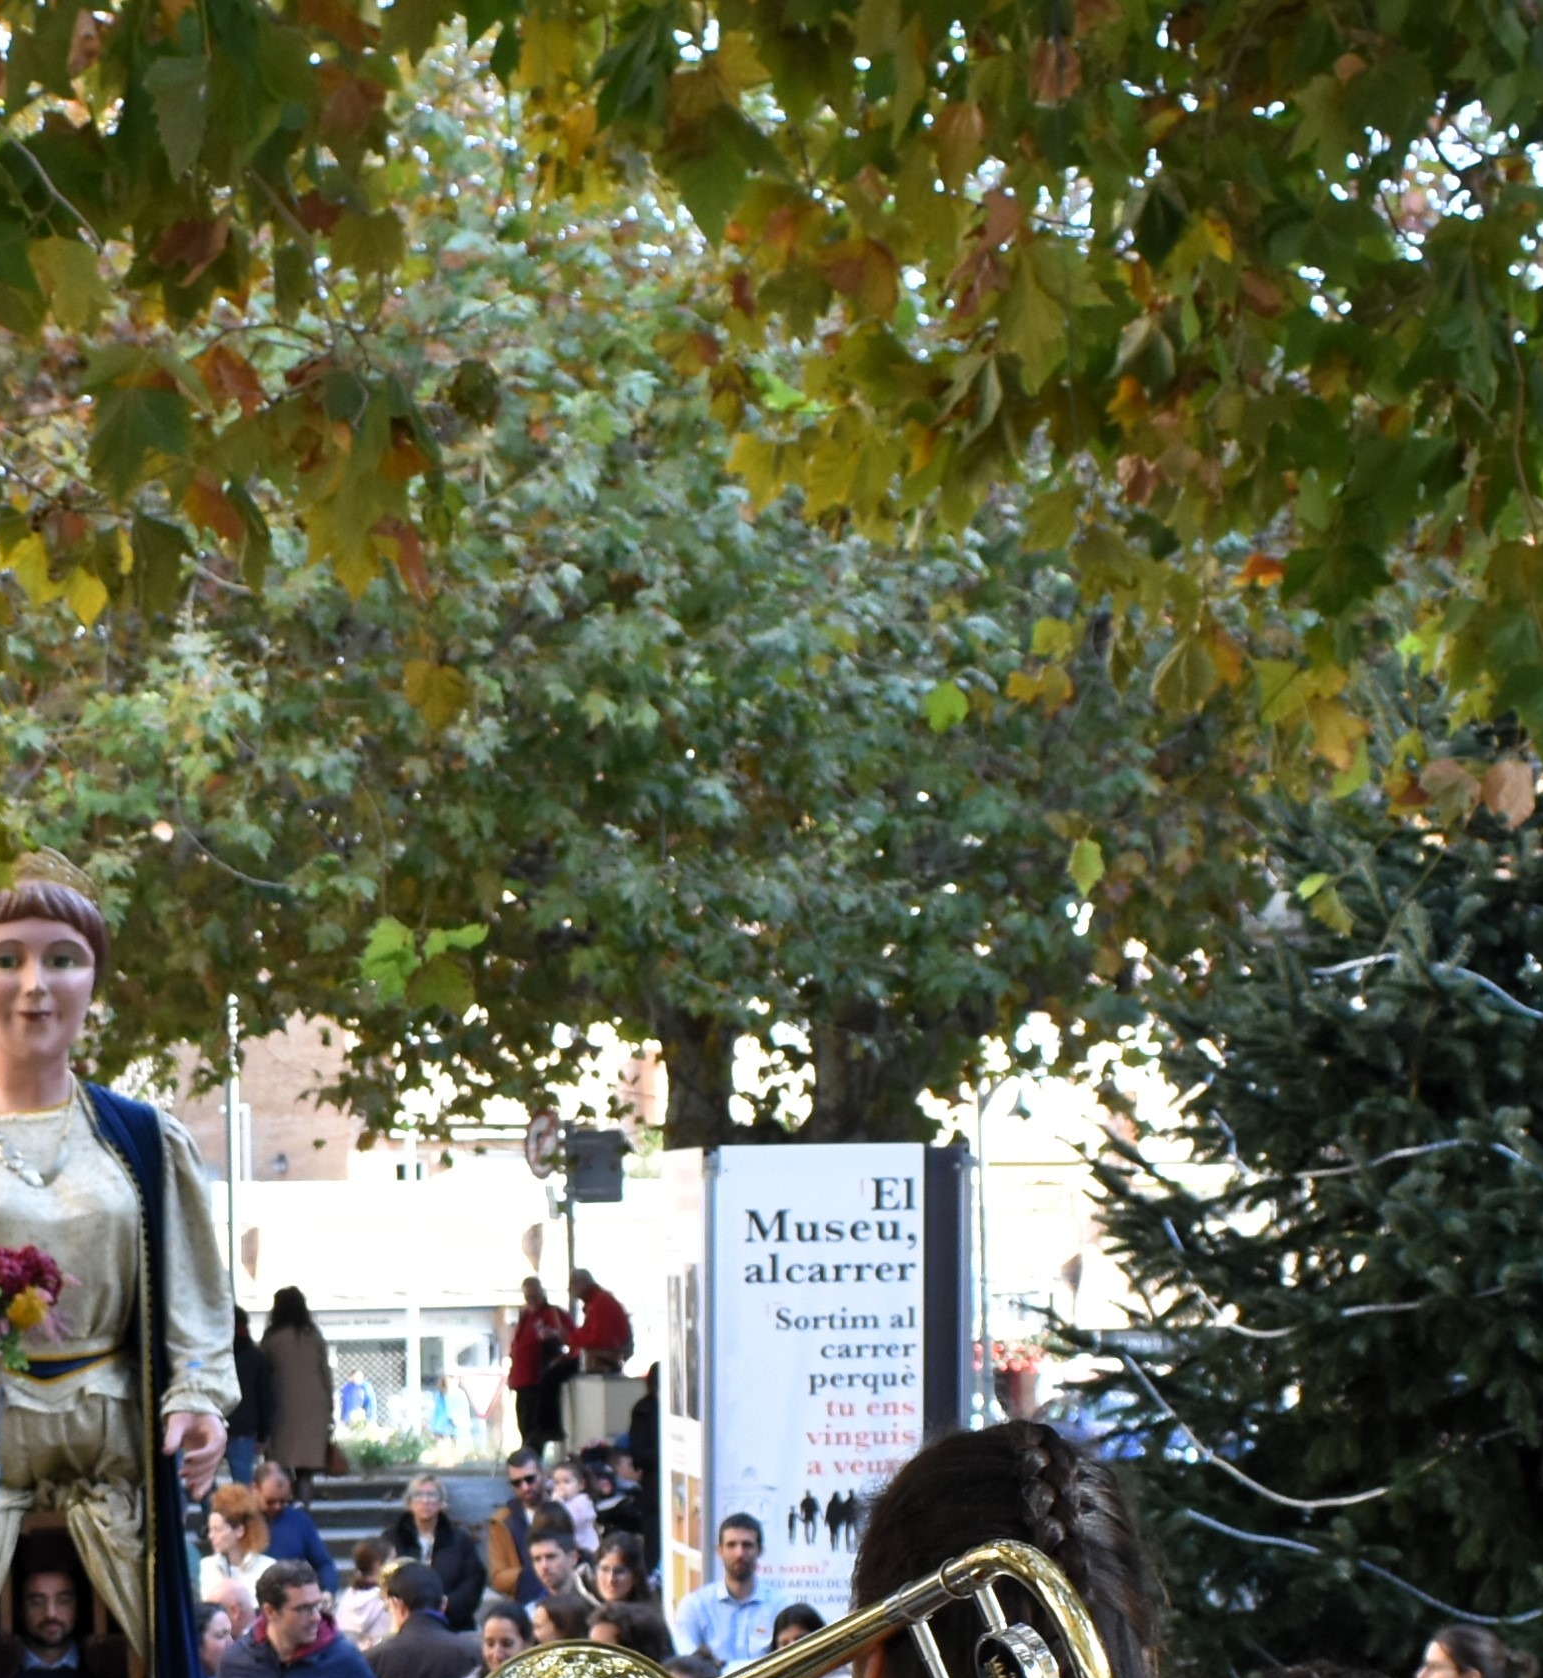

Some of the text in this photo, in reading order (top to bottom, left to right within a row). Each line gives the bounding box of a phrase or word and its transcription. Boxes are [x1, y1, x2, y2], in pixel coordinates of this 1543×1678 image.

[871, 1177, 916, 1211] El
[745, 1208, 917, 1250] Museu,
[775, 1306, 916, 1331] Sortim al
[820, 1342, 916, 1359] carrer
[809, 1365, 916, 1396] perquè
[826, 1400, 916, 1417] tu ens
[806, 1422, 916, 1452] vinguis
[807, 1459, 907, 1475] a veur
[826, 1579, 842, 1589] DE
